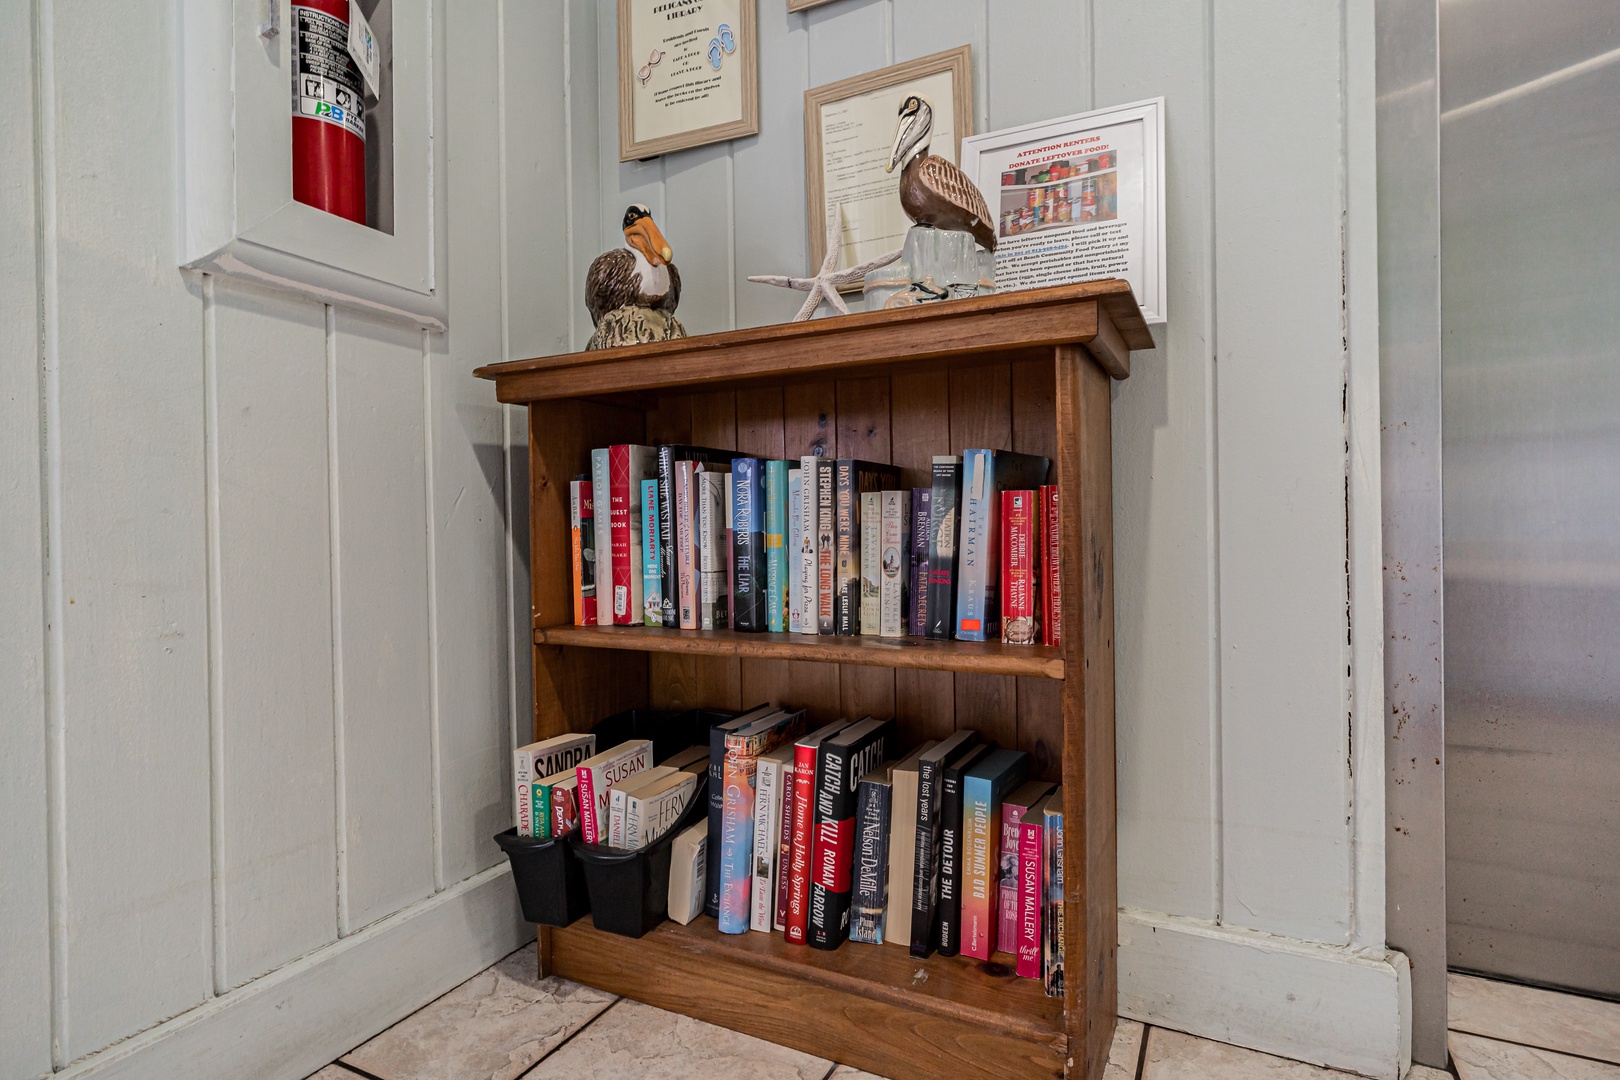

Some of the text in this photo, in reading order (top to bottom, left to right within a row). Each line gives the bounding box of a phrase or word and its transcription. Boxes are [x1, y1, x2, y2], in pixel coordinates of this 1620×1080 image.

[666, 5, 703, 20] LIBRARY
[1009, 144, 1110, 169] DONATE LEFTOVER FOOD!
[1017, 136, 1100, 158] ATTENTION RENTERS
[596, 456, 604, 497] PARLOR
[660, 500, 670, 520] WAS
[734, 480, 750, 545] NORA ROBERTS
[820, 466, 831, 530] STEPHEN KING
[839, 466, 850, 556] DAYS YOU WERE MINE
[662, 523, 670, 540] BAD
[917, 511, 928, 548] BRENNAN
[738, 555, 750, 593] THE LIAR
[802, 558, 812, 613] Playing for Pizza
[820, 550, 831, 616] THE LONG WALK
[917, 572, 928, 627] FATAL SECRETS
[968, 580, 976, 616] KRAUS
[534, 744, 592, 778] SANDRA
[606, 755, 644, 787] SUSAN
[795, 766, 814, 776] KARON
[850, 737, 884, 792] CATCH
[518, 784, 529, 832] CHARADE
[581, 783, 594, 843] SUSAN MALLERY
[659, 791, 685, 828] FERN
[725, 743, 741, 843] JOHN GRISHAM
[819, 753, 842, 844] CATCH AND KILL
[920, 765, 932, 821] the lost years
[555, 806, 564, 829] DEATH
[757, 789, 768, 856] FERN MICHAELS
[783, 805, 791, 840] SHIELDS
[790, 792, 807, 915] Home to Holly Springs
[861, 821, 880, 856] Nelson
[973, 801, 987, 899] BAD SUMMER PEOPLE
[823, 848, 836, 887] RONAN
[859, 856, 878, 896] DeMille
[942, 829, 953, 900] THE DETOUR
[1025, 860, 1035, 896] SUSAN
[722, 863, 734, 926] THE EXCHANGE
[812, 882, 826, 928] FARROW
[855, 926, 876, 940] Island
[860, 917, 875, 930] Plum
[1024, 898, 1035, 941] MALLERY
[1019, 945, 1039, 957] thrill
